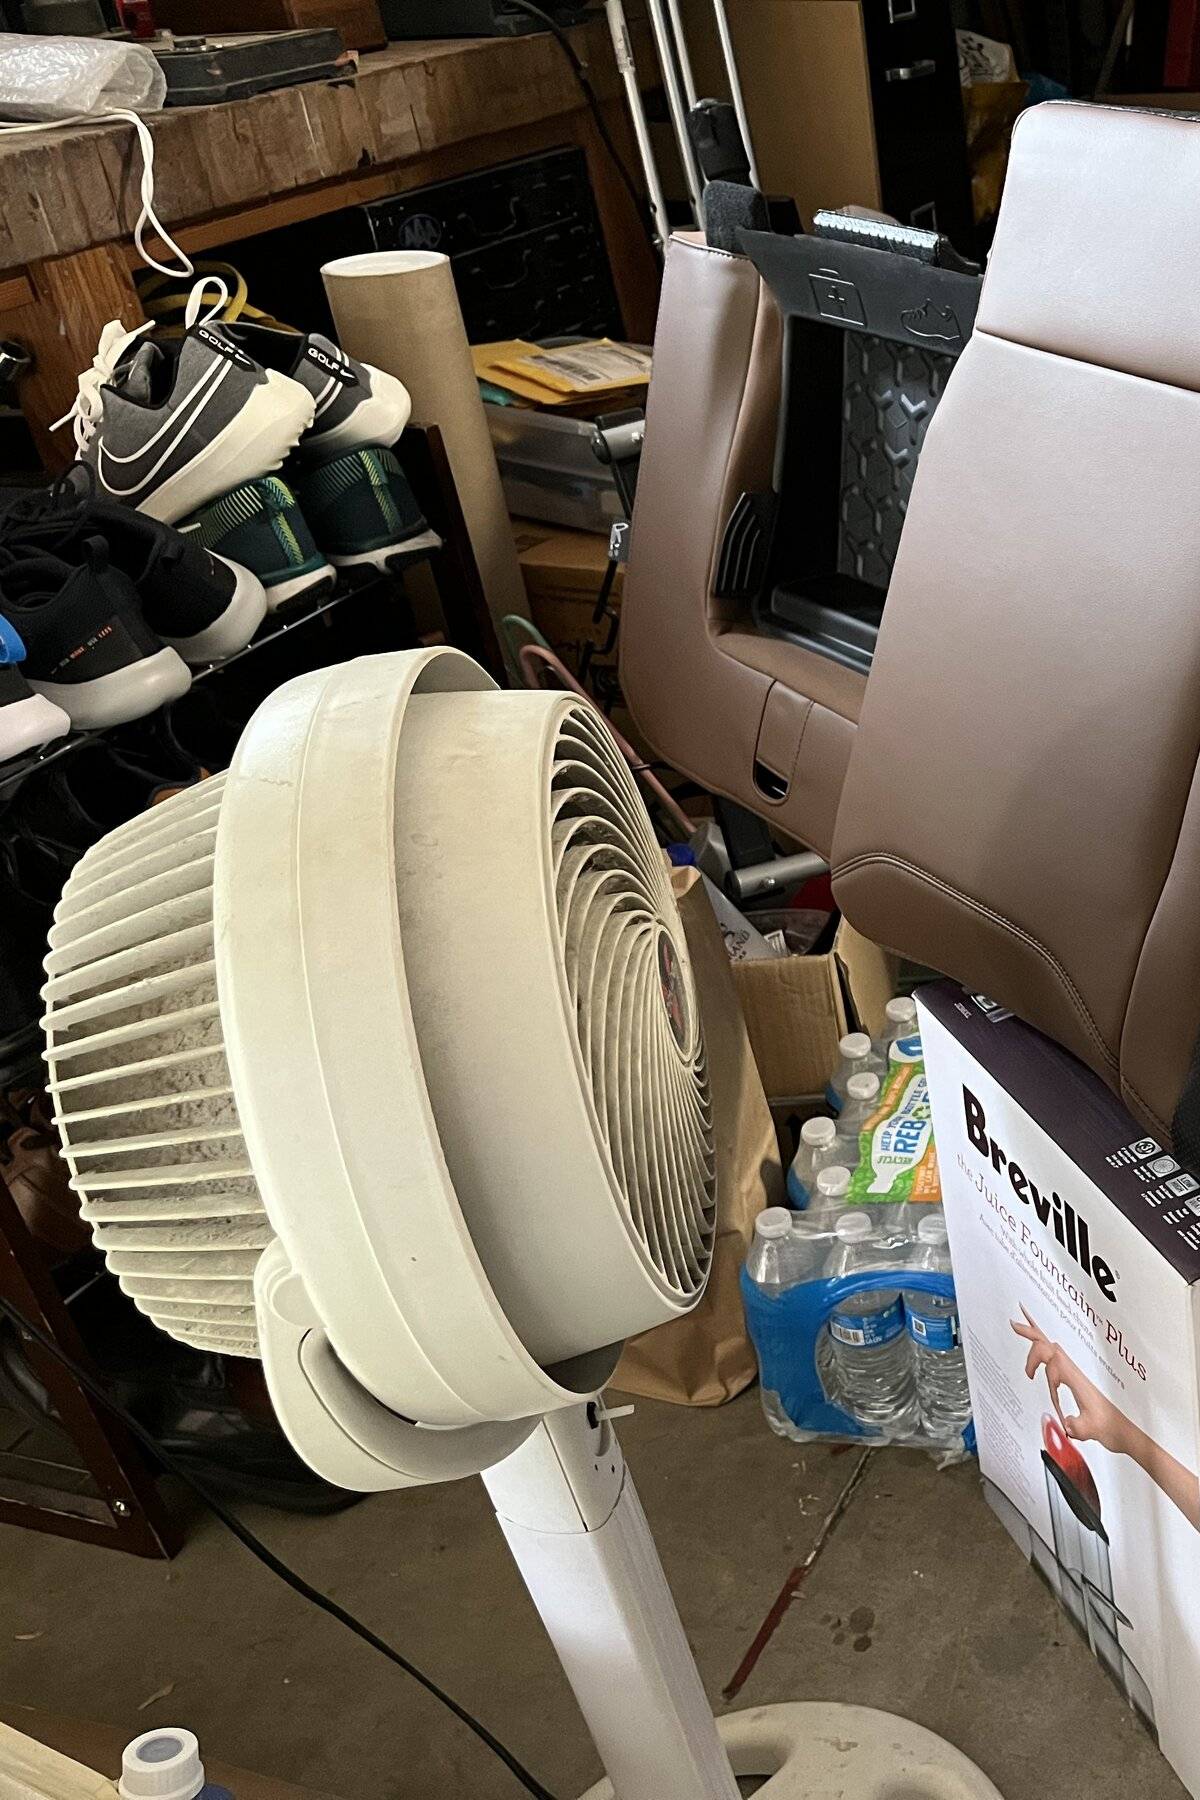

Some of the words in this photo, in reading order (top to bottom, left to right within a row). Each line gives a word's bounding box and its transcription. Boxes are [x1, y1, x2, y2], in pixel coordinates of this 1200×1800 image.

[198, 329, 235, 354] GOLF
[307, 346, 341, 371] GOLF
[962, 1083, 1118, 1303] Breville
[975, 1173, 1017, 1232] Juice
[1020, 1220, 1098, 1327] Fountain
[1105, 1319, 1146, 1381] Plus
